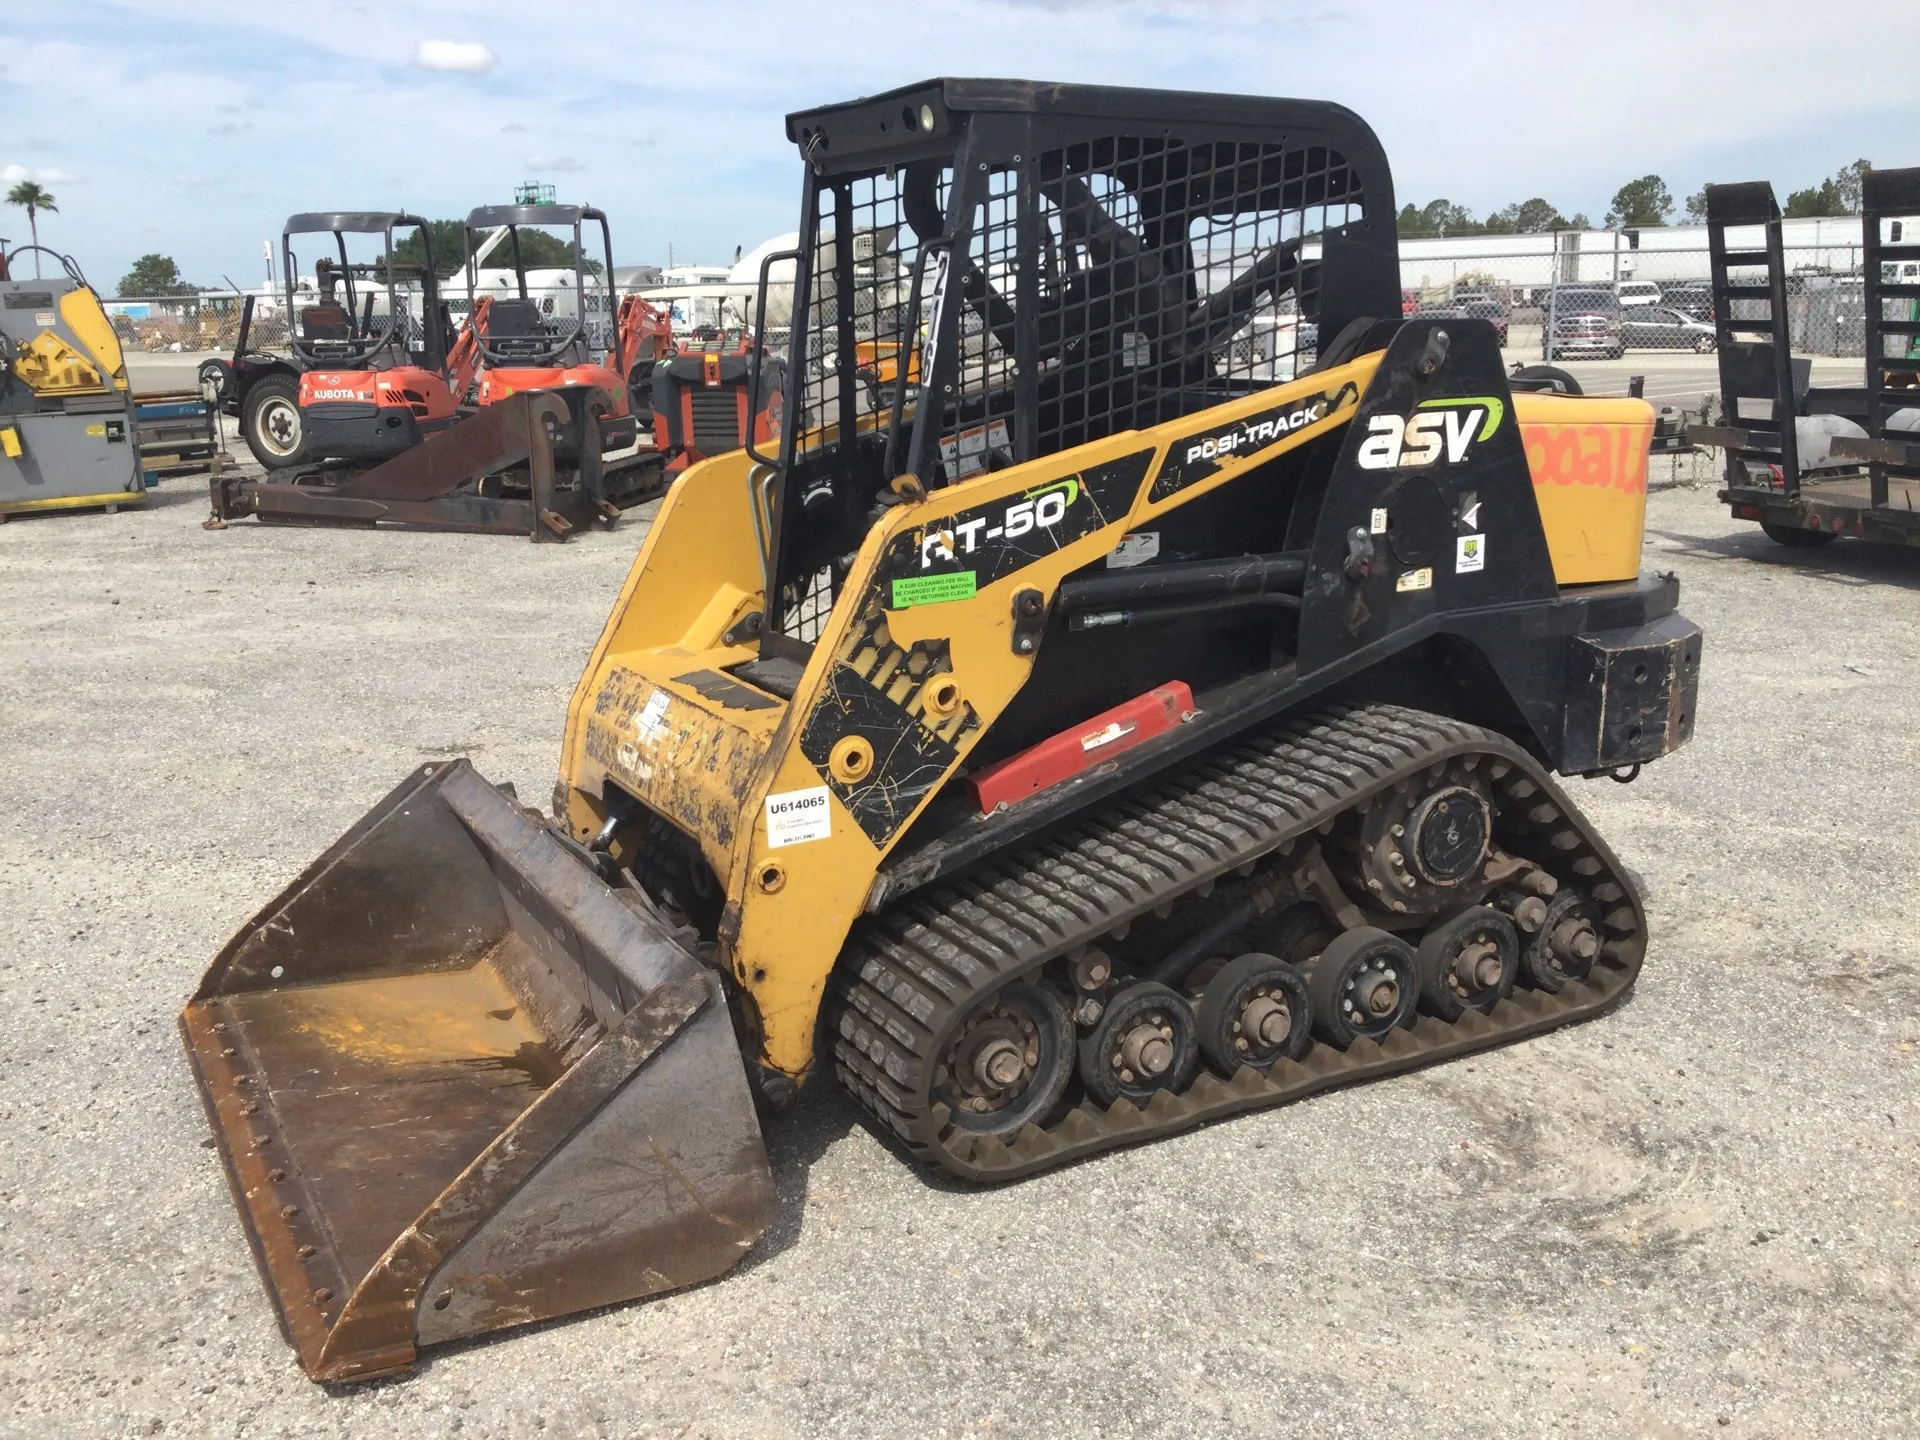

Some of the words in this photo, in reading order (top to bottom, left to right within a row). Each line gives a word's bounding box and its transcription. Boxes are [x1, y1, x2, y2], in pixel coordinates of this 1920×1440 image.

[313, 389, 355, 400] KUBOTA
[1186, 404, 1320, 465] POSI-TRACK
[921, 491, 1066, 569] RT-50
[917, 579, 945, 587] CLEANING
[950, 582, 974, 590] MACHINE
[920, 592, 950, 600] RETURNED
[950, 589, 968, 597] CLEAN
[770, 795, 826, 815] U614065
